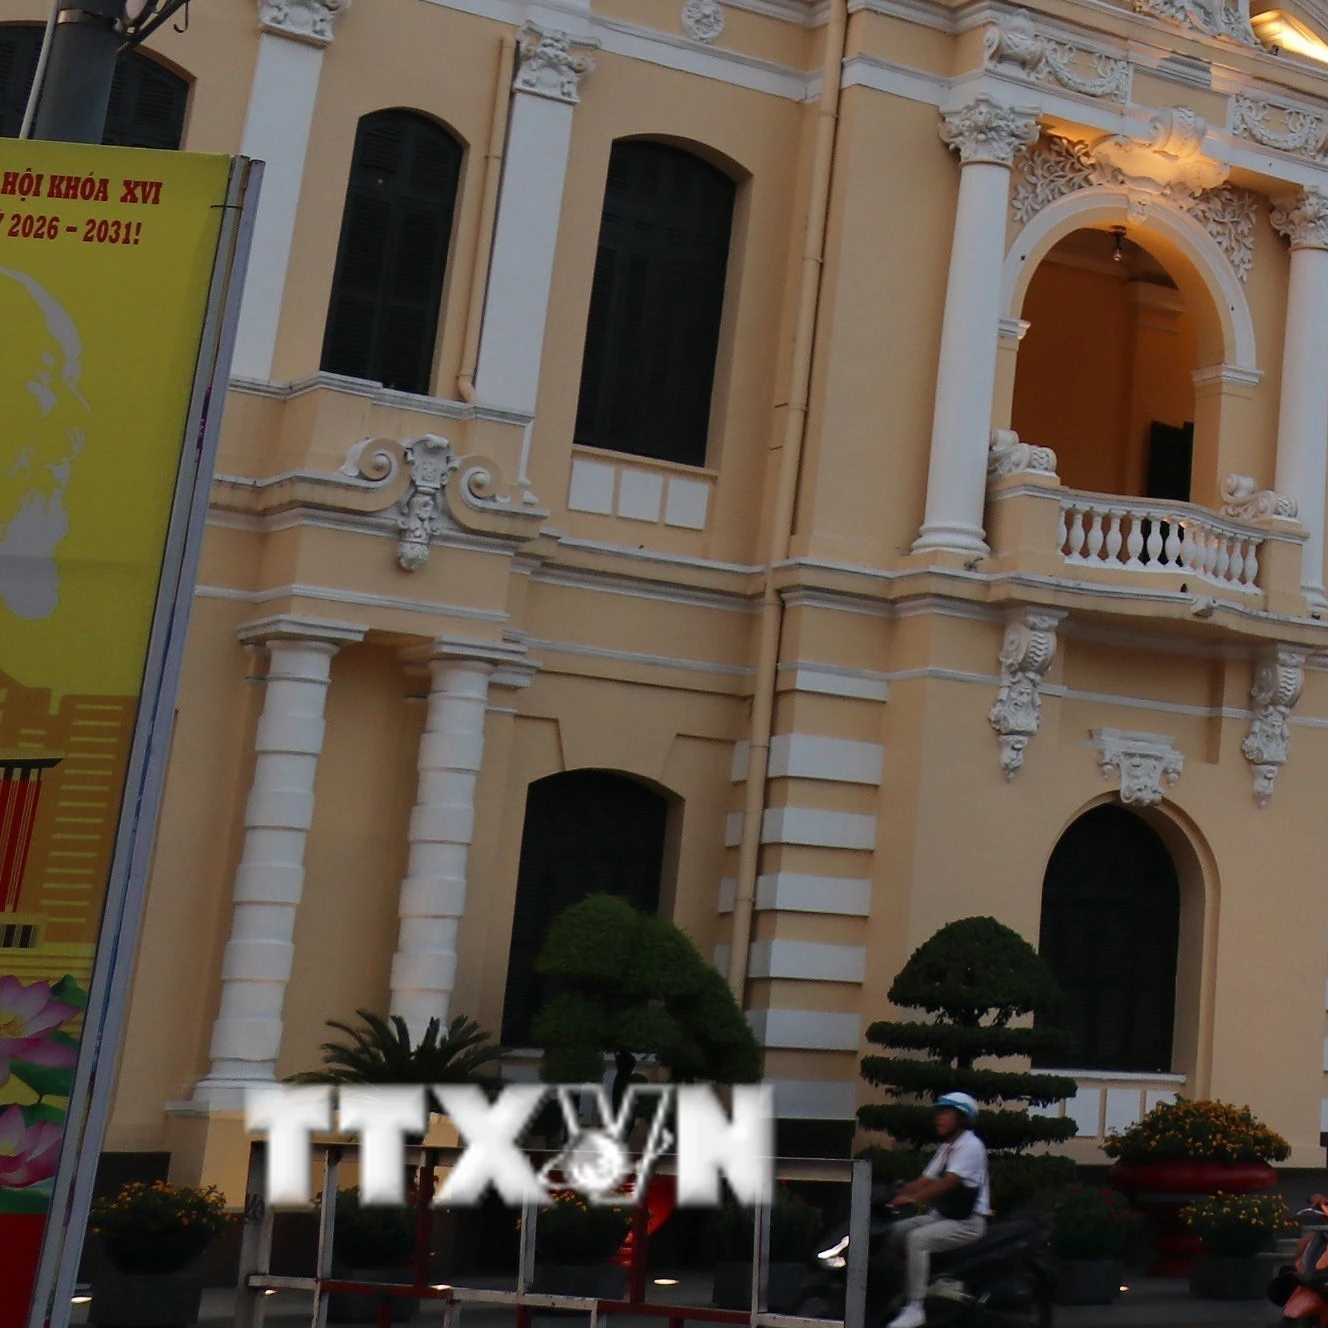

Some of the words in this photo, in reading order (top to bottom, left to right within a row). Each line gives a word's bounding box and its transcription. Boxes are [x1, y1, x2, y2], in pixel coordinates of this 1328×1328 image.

[1, 168, 43, 201] HỘI
[47, 172, 109, 202] KHÓA
[120, 180, 163, 204] XVI
[8, 213, 60, 240] 2026
[83, 219, 142, 245] 2031!
